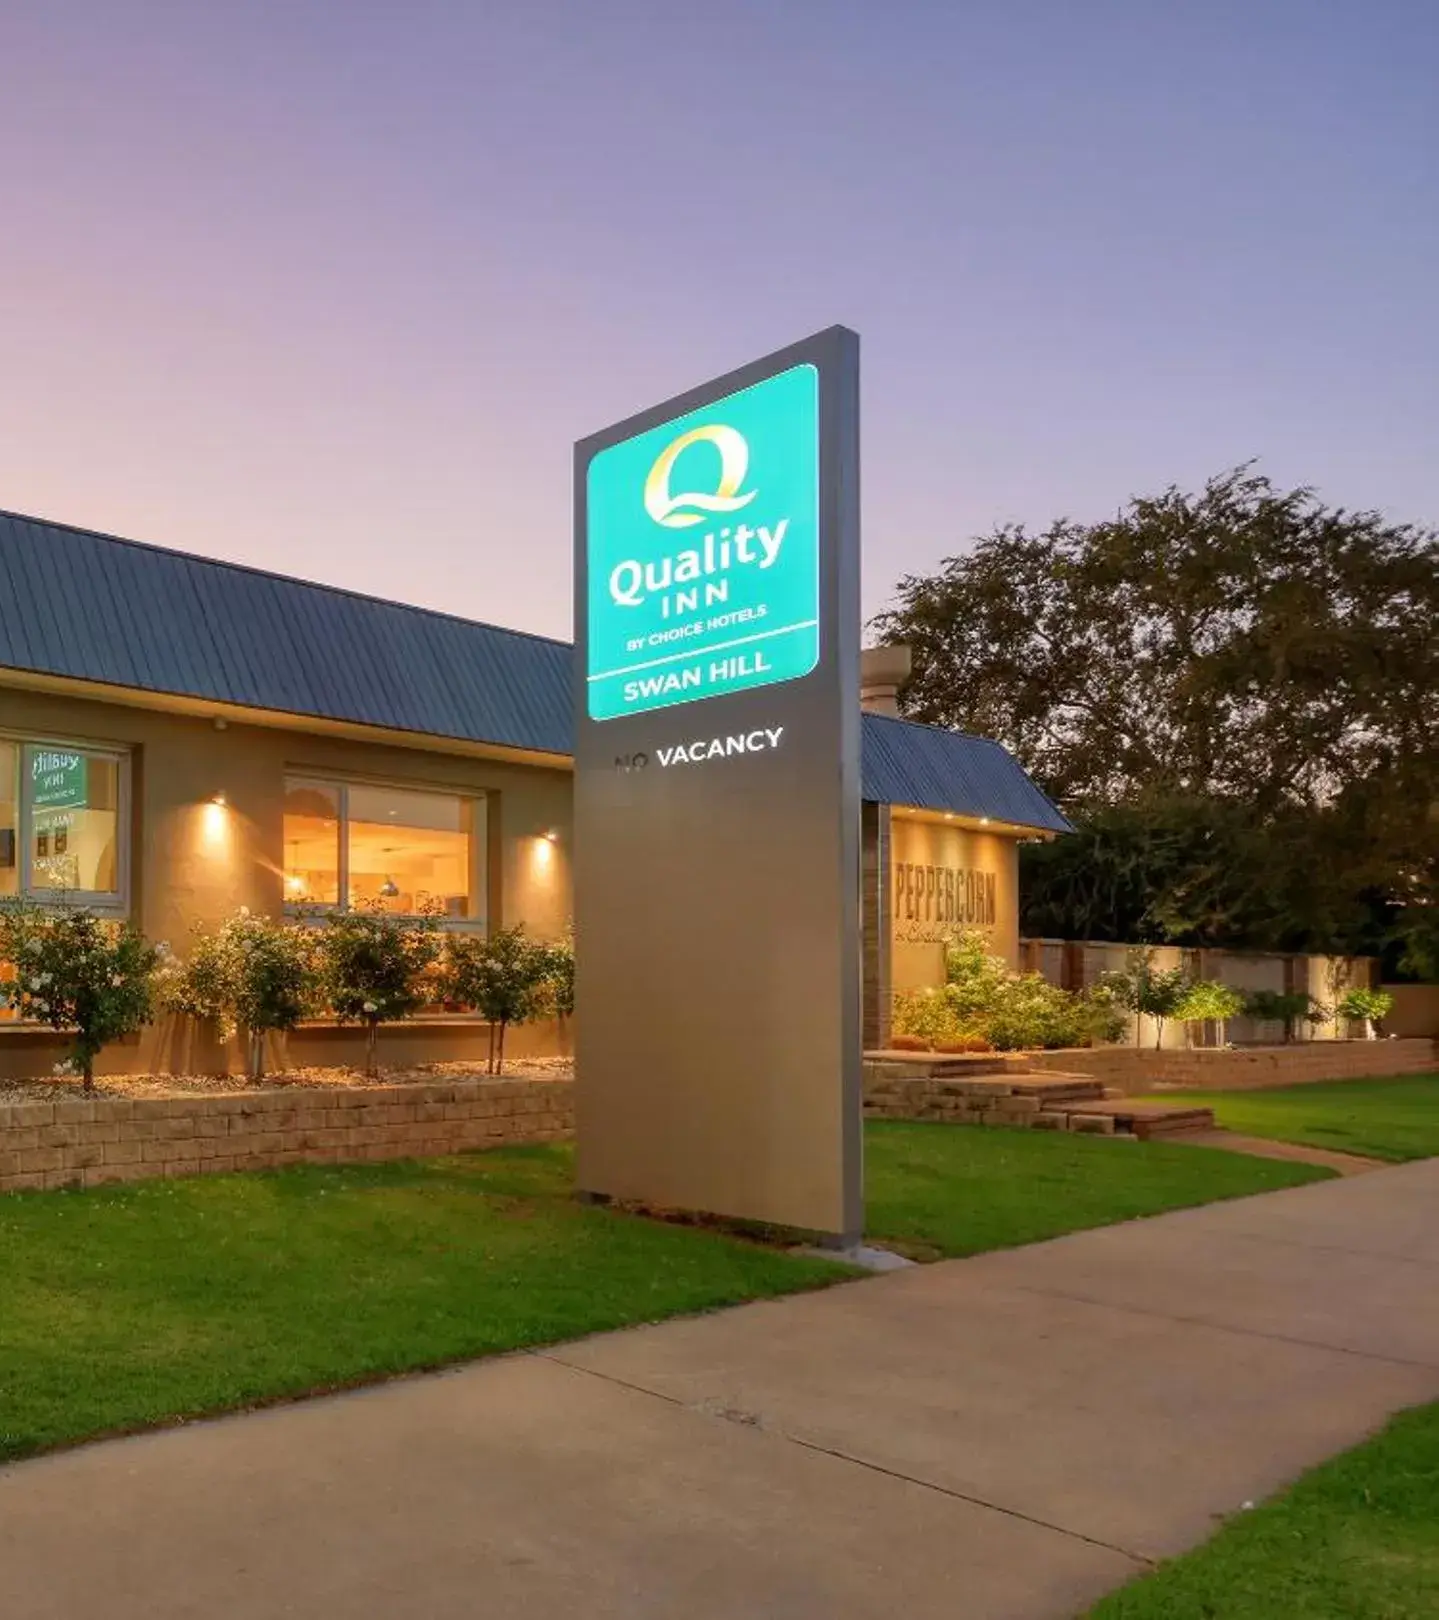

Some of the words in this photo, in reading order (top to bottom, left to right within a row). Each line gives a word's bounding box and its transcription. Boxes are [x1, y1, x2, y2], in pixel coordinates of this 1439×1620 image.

[644, 424, 758, 527] Q
[609, 518, 789, 606] Quality
[662, 578, 728, 618] INN
[626, 638, 645, 652] BY
[648, 621, 704, 646] CHOICE
[707, 604, 768, 630] HOTELS
[624, 666, 701, 702] SWAN
[710, 651, 772, 684] HILL
[656, 727, 784, 767] VACANCY
